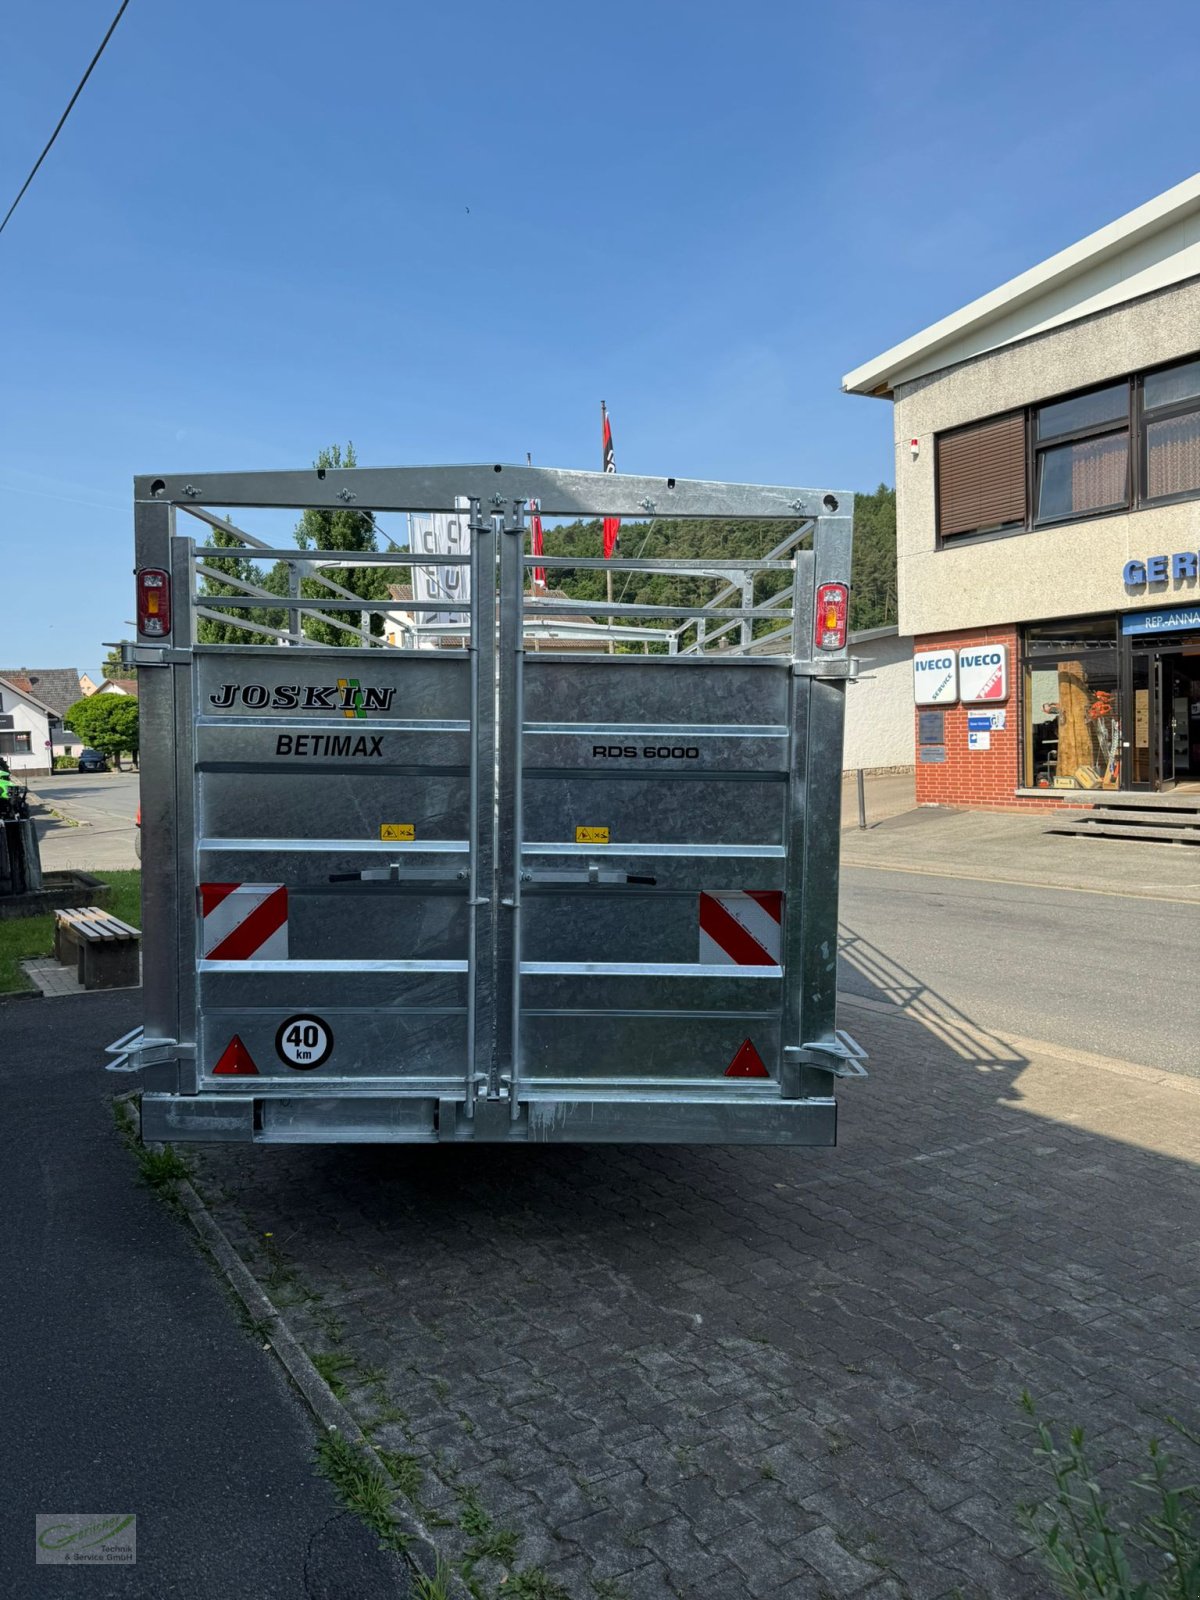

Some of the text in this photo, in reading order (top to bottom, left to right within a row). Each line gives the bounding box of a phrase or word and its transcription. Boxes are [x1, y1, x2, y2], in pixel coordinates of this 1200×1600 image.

[1123, 550, 1200, 585] GER
[915, 657, 952, 672] IVECO
[960, 653, 1001, 668] IVECO
[932, 672, 953, 700] SERVICE
[980, 669, 1002, 698] PARTS
[209, 683, 397, 711] JOSKIN
[276, 734, 384, 757] BETIMAX
[592, 746, 699, 758] RDS 6000
[286, 1025, 319, 1048] 40
[296, 1049, 312, 1060] km
